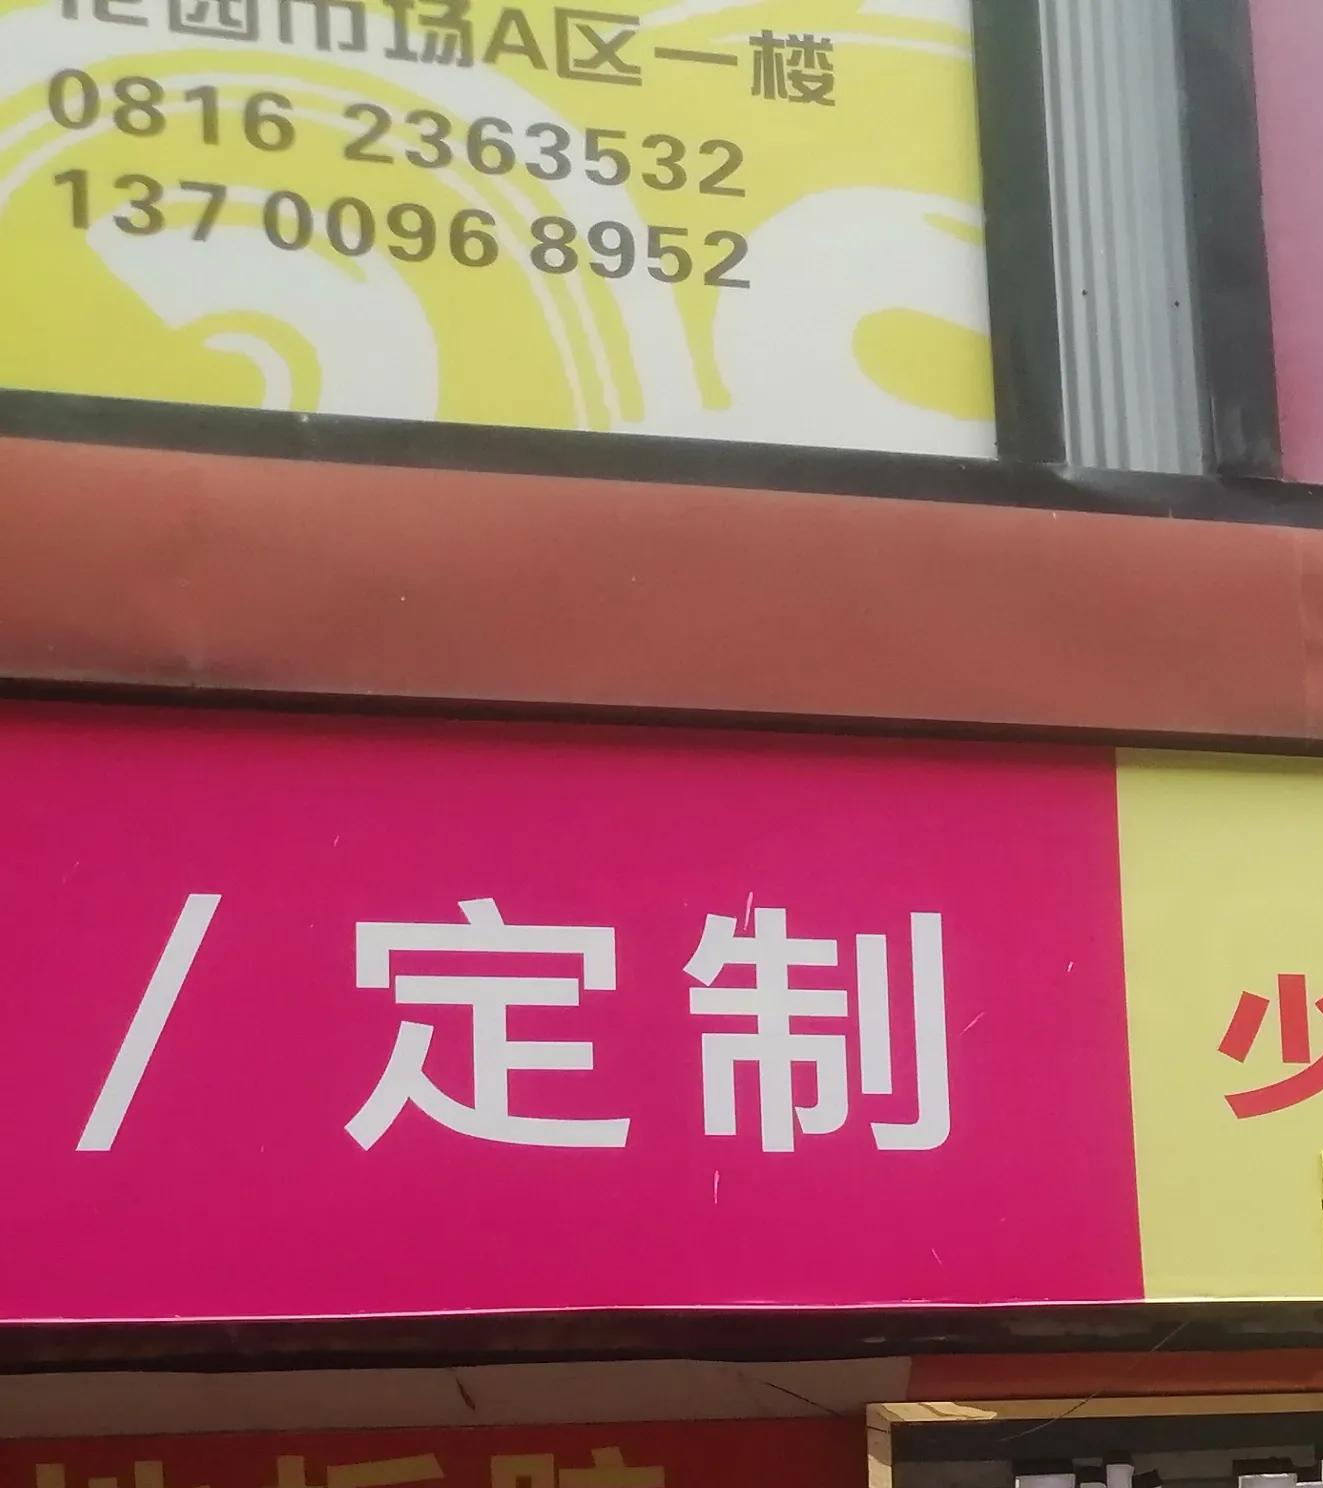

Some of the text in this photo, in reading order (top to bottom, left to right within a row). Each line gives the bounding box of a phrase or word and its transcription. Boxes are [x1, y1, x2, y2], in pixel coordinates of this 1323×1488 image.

[47, 68, 748, 197] 0816 2363532
[52, 168, 752, 289] 137 0096 8952
